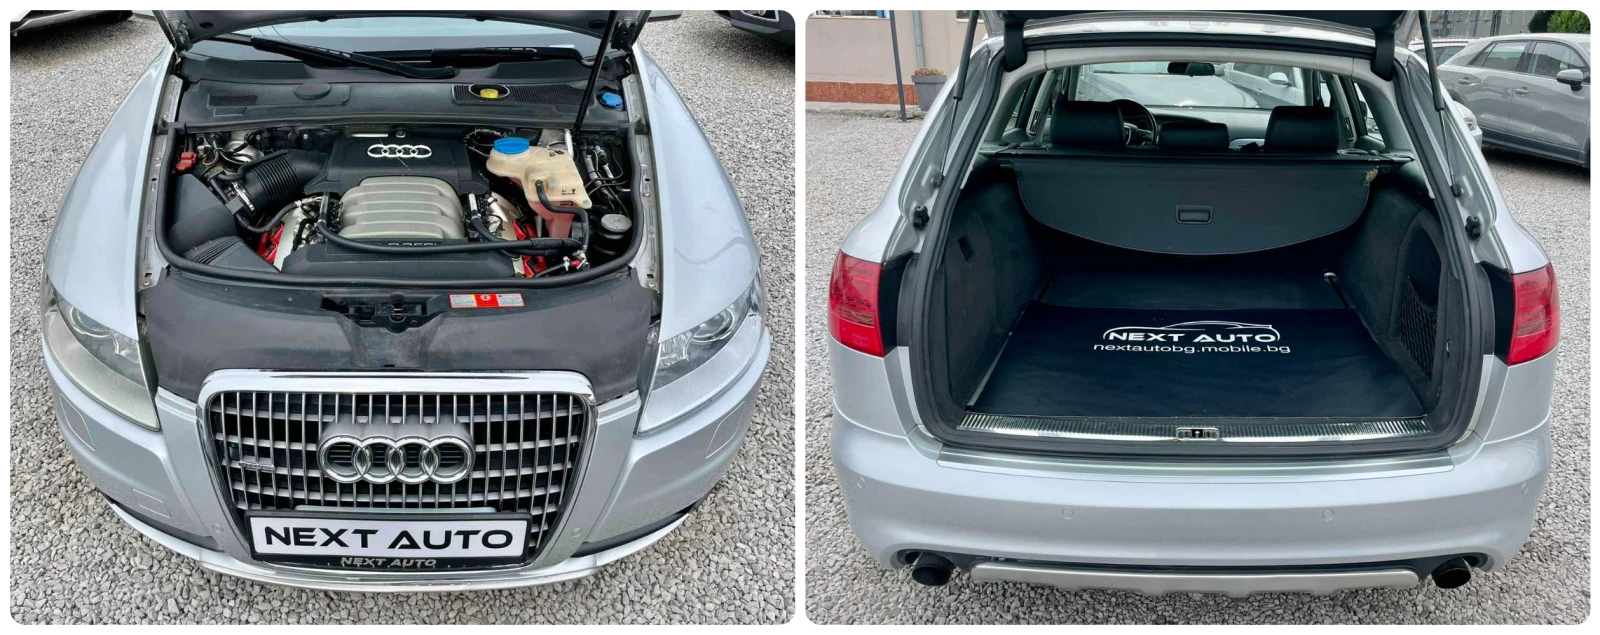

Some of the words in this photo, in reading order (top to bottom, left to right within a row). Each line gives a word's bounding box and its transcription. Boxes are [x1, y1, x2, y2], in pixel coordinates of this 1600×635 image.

[1108, 332, 1186, 342] NEXT
[1192, 333, 1276, 343] AUTO
[1093, 343, 1291, 354] nextautobg.mobile.bg
[264, 526, 379, 549] NEXT
[387, 529, 513, 550] AUTO
[340, 556, 387, 566] NEXT
[389, 558, 437, 567] AUTO
